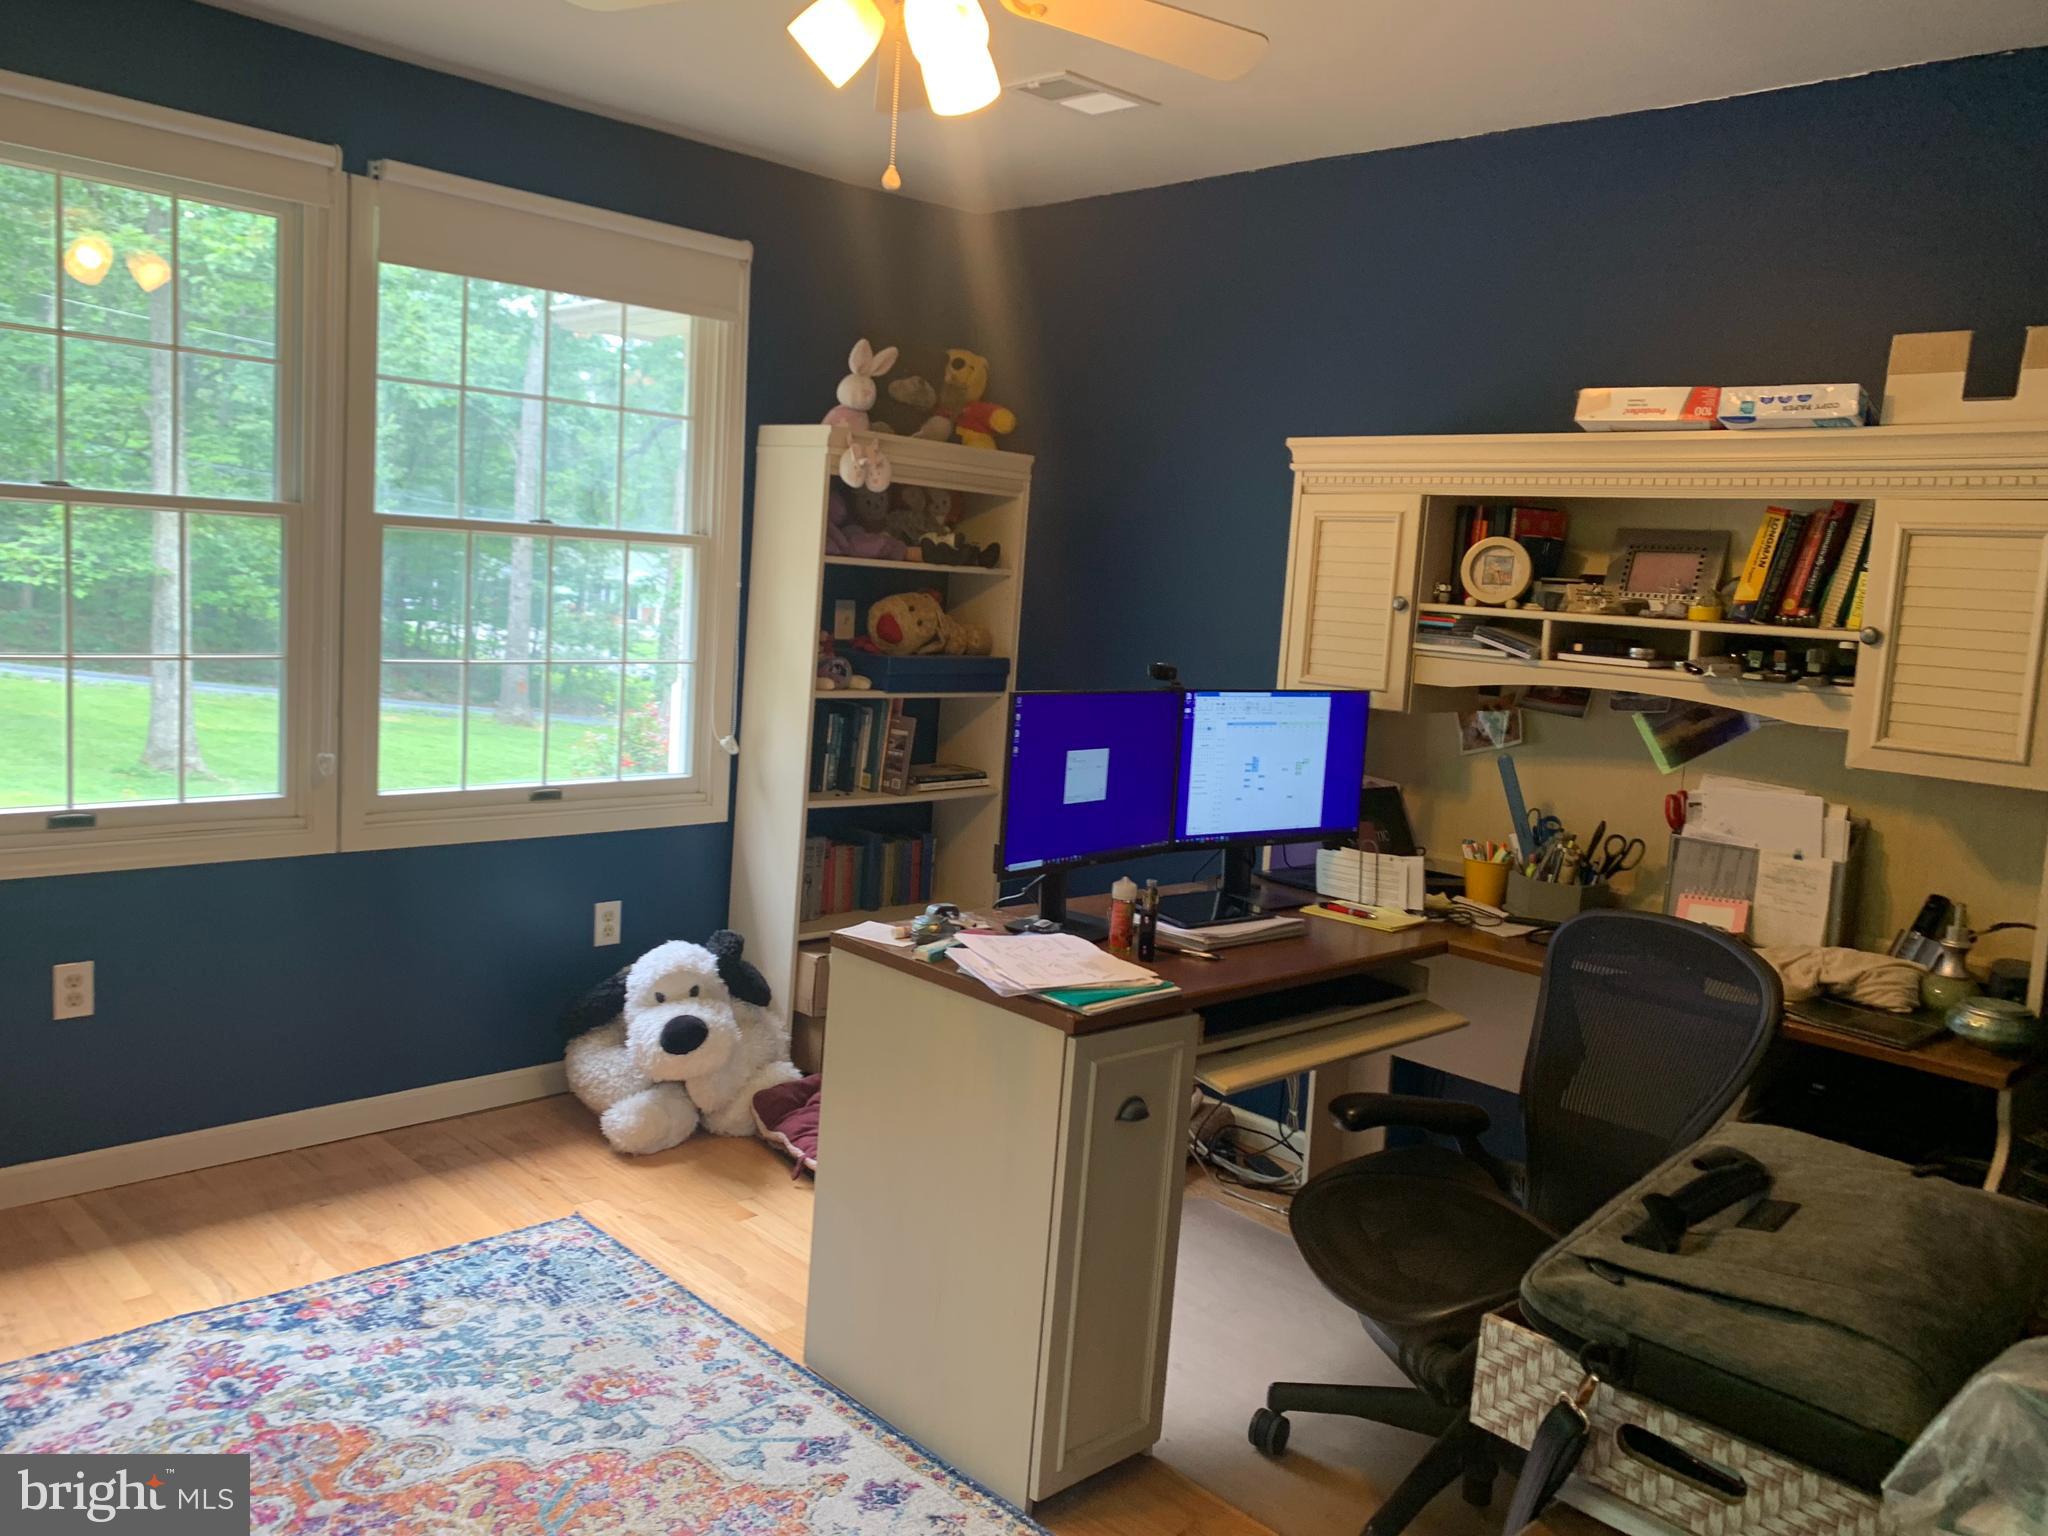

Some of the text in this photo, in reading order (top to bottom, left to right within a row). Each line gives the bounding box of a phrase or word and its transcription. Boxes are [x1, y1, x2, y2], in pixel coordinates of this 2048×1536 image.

[1693, 406, 1713, 417] 100
[1782, 403, 1812, 412] PAPER
[1758, 517, 1781, 569] LONGMAN
